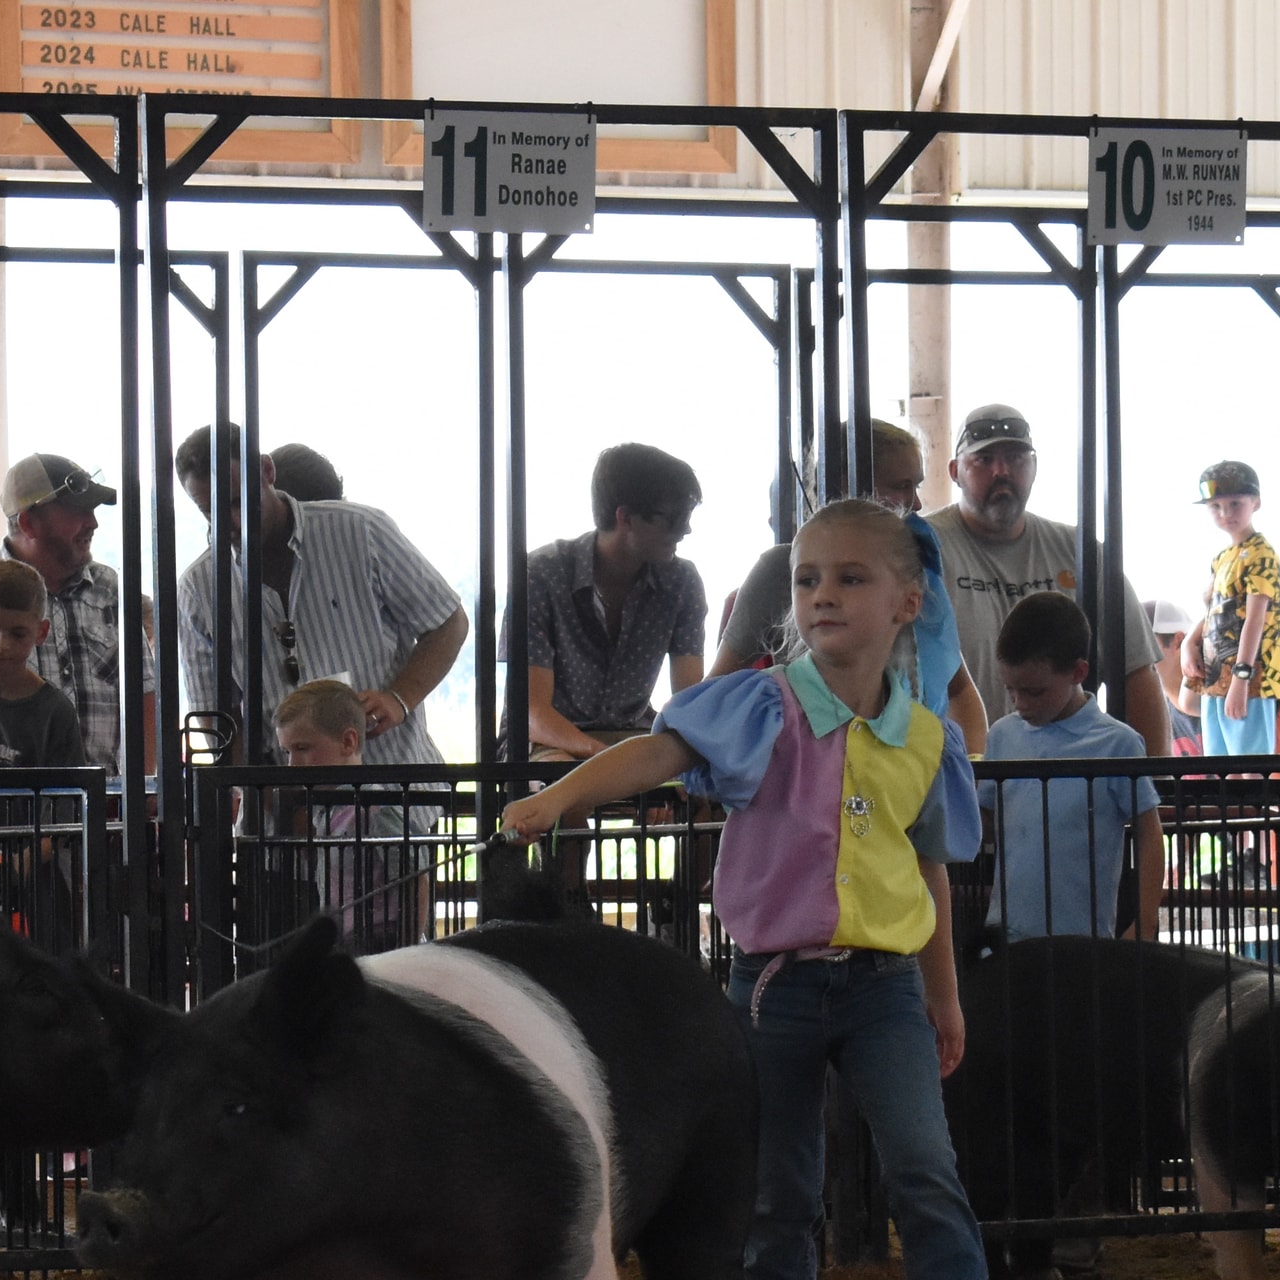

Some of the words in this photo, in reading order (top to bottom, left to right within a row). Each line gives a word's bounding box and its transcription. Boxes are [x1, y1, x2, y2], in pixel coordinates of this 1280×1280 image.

[40, 9, 97, 29] 2023
[119, 13, 167, 33] CALE
[189, 16, 236, 37] HALL
[40, 45, 97, 65] 2024
[120, 49, 169, 69] CALE
[186, 52, 236, 73] HALL
[492, 131, 506, 145] In
[511, 132, 570, 150] Memory
[575, 133, 590, 147] of
[511, 152, 567, 175] Ranae
[1161, 146, 1173, 158] In
[1176, 147, 1224, 161] Memory
[1227, 147, 1239, 159] of
[431, 125, 488, 217] 11
[1162, 164, 1189, 181] M.W.
[1193, 164, 1241, 181] RUNYAN
[498, 184, 579, 207] Donohoe
[1095, 139, 1156, 232] 10
[1166, 190, 1183, 206] 1st
[1187, 190, 1203, 206] PC
[1207, 190, 1237, 206] Pres.
[1187, 215, 1214, 231] 1944
[957, 576, 1054, 597] carhartt
